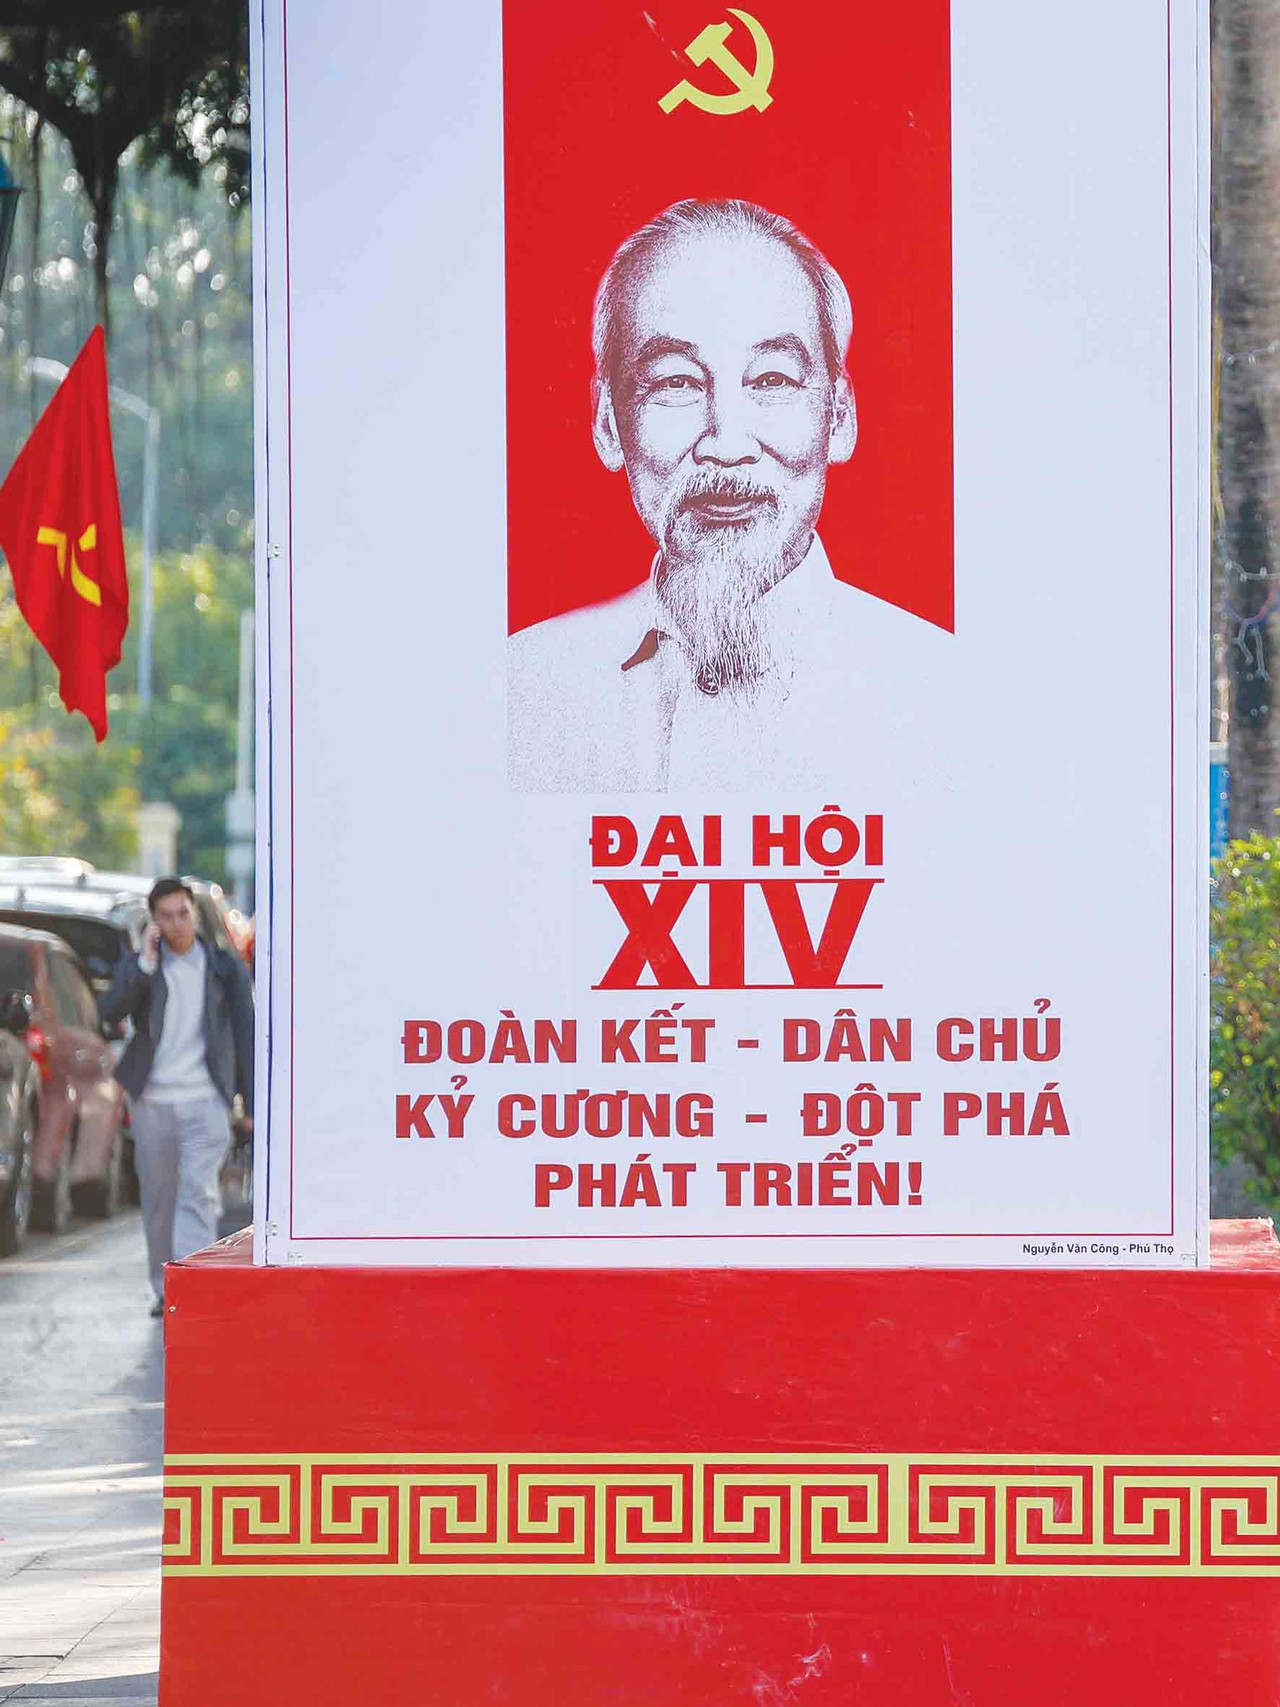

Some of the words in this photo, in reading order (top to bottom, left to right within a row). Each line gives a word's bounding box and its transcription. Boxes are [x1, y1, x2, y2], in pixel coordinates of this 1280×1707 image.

[589, 815, 722, 877] ĐẠI
[753, 805, 883, 876] HỘI
[592, 878, 884, 990] XIV
[402, 1010, 576, 1064] ĐOÀN
[602, 1002, 715, 1063] KẾT
[783, 1009, 912, 1062] DÂN
[937, 998, 1061, 1062] CHỦ
[396, 1075, 474, 1138] KỶ
[498, 1088, 714, 1138] CƯƠNG
[800, 1083, 921, 1147] ĐỘT
[943, 1082, 1069, 1137] PHÁ
[535, 1154, 696, 1207] PHÁT
[717, 1143, 922, 1206] TRIỂN!
[1022, 1242, 1064, 1256] Nguyễn
[1066, 1243, 1087, 1254] Văn
[1090, 1243, 1119, 1256] Công
[1129, 1243, 1151, 1254] Phú
[1153, 1243, 1174, 1256] Thọ
